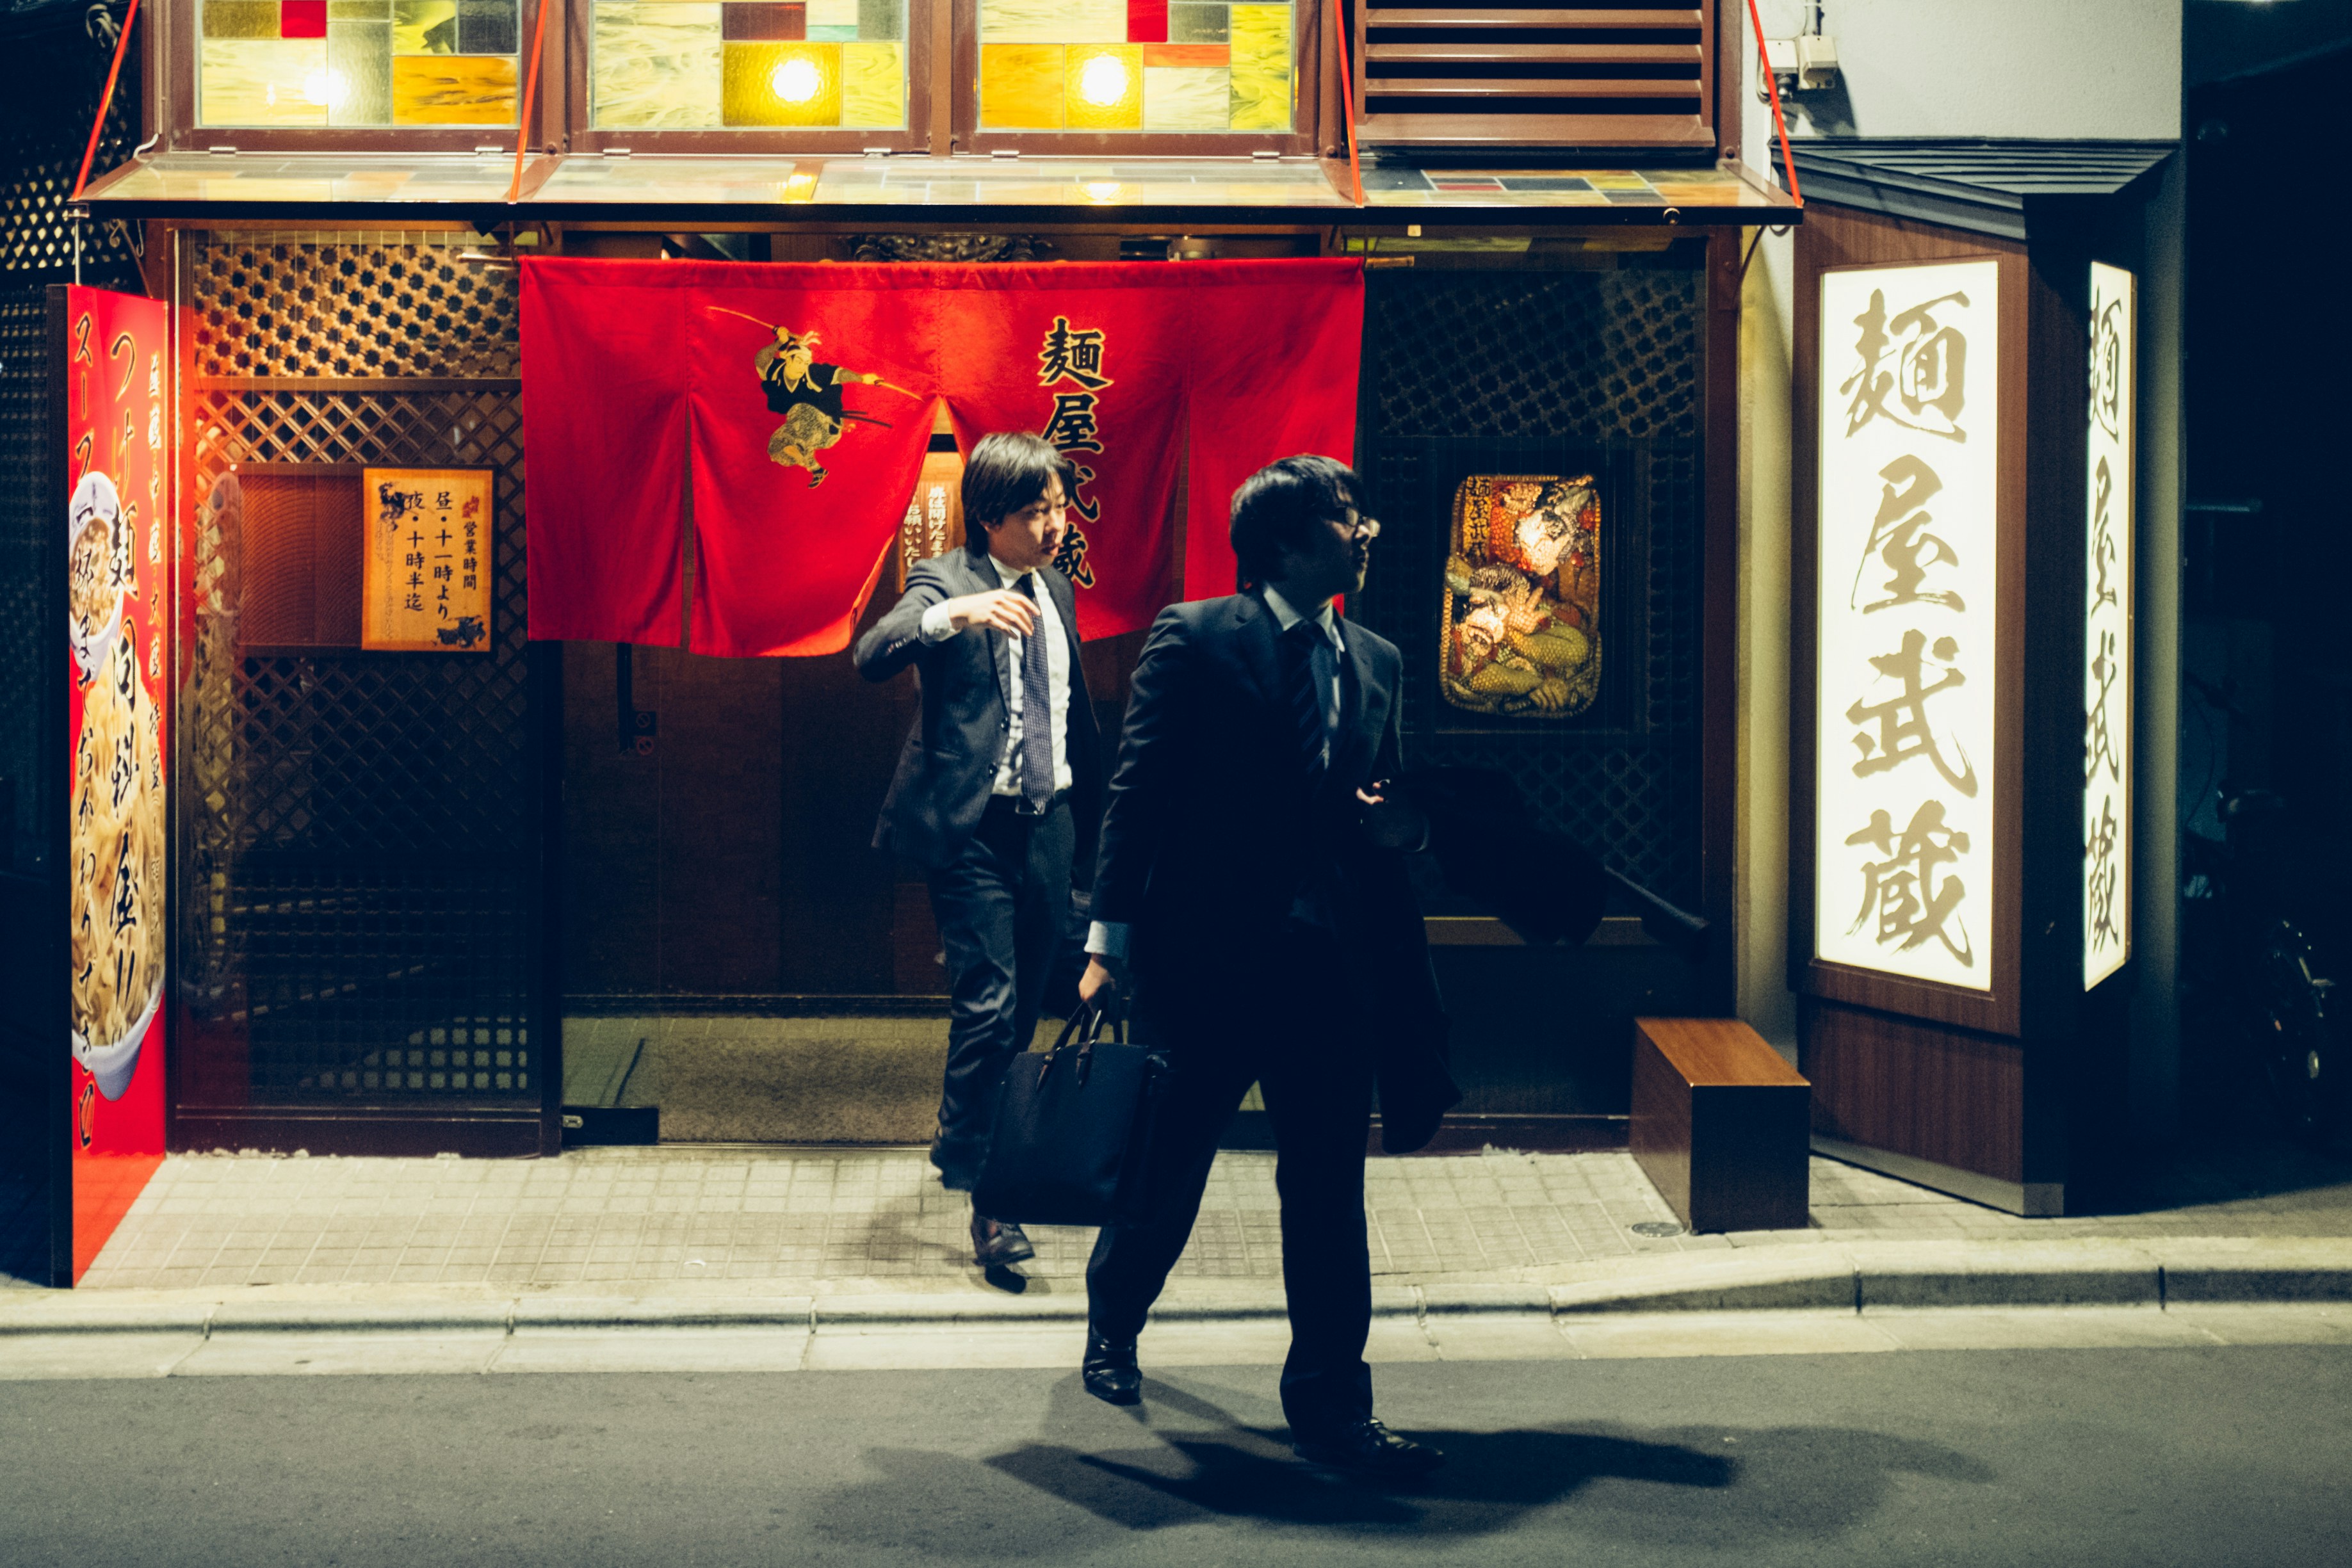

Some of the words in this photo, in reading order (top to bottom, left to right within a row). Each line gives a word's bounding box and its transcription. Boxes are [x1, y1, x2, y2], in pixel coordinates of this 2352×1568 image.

[462, 521, 478, 590] 営業時間
[1838, 287, 1978, 969] 麺屋武蔵
